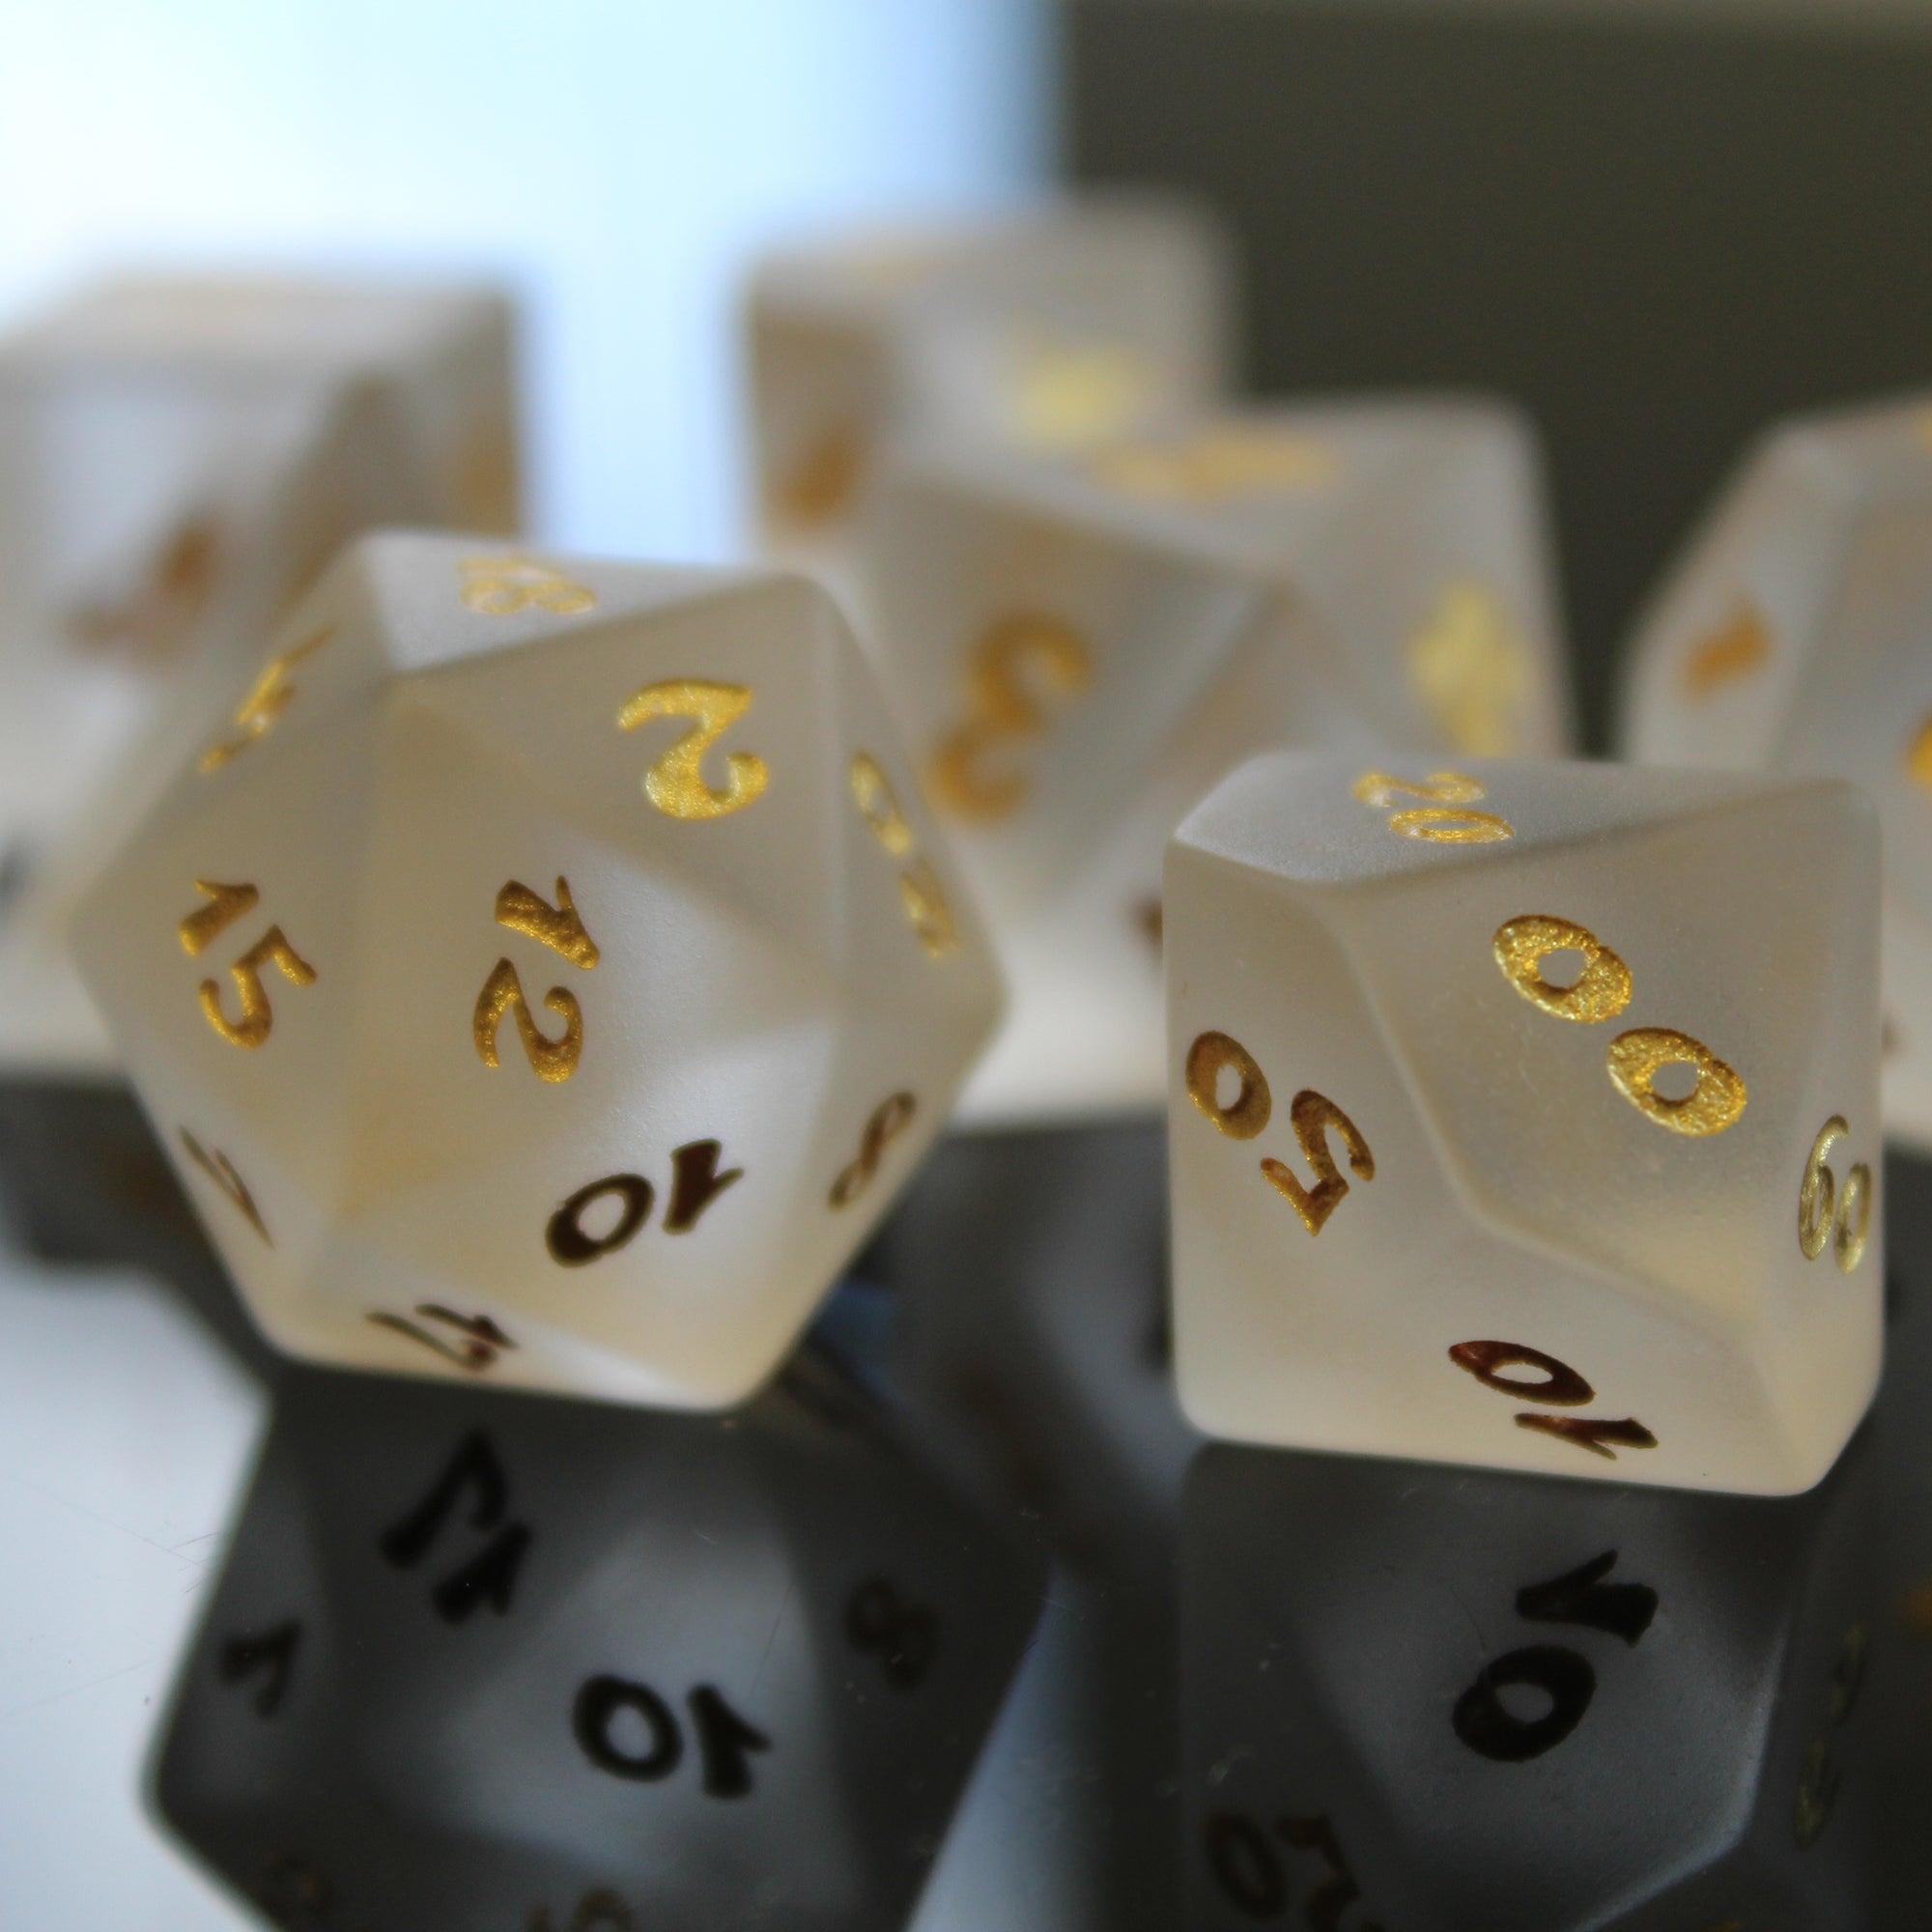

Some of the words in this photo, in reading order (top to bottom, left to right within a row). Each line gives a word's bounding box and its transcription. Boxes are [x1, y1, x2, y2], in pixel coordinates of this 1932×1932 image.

[616, 677, 768, 821] 2
[1351, 770, 1515, 845] 20
[179, 878, 318, 1051] 15
[472, 874, 601, 1084] 12
[1492, 913, 1748, 1138] 00
[544, 1137, 746, 1268] 10
[1185, 1030, 1377, 1237] 50
[1798, 1114, 1872, 1275] 60
[1447, 1339, 1659, 1461] 10
